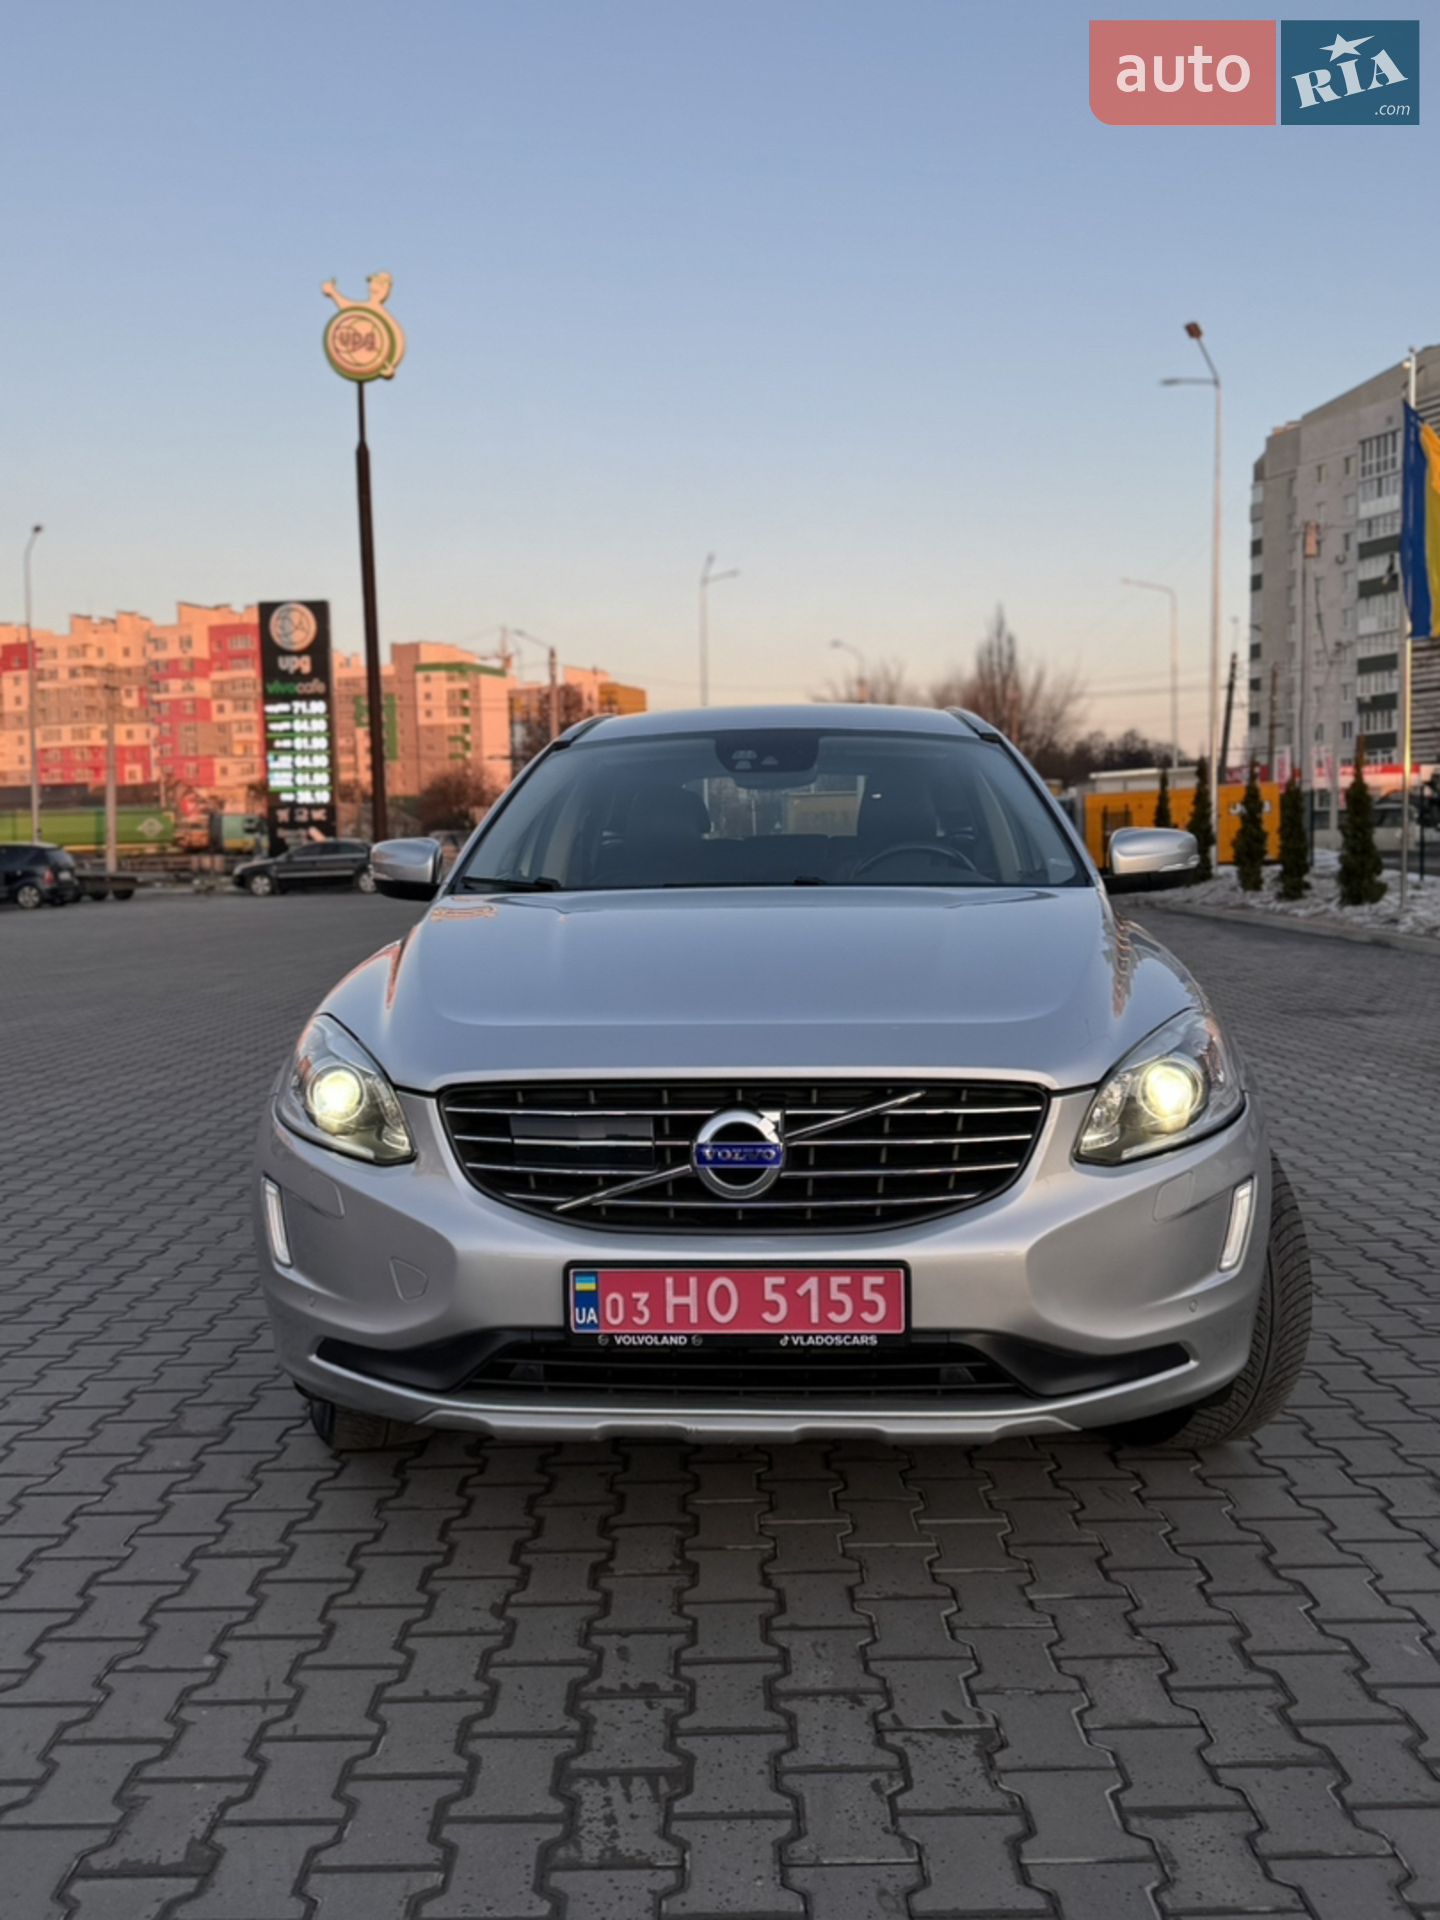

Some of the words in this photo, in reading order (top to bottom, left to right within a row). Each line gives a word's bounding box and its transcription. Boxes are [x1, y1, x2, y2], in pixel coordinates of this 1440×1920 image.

[703, 1148, 777, 1161] VOLVO
[605, 1292, 650, 1326] 03
[664, 1276, 739, 1324] HO
[761, 1276, 887, 1324] 5155
[575, 1307, 598, 1324] UA
[614, 1335, 687, 1346] VOLVOLAND
[791, 1334, 878, 1347] VLADOSCARS
